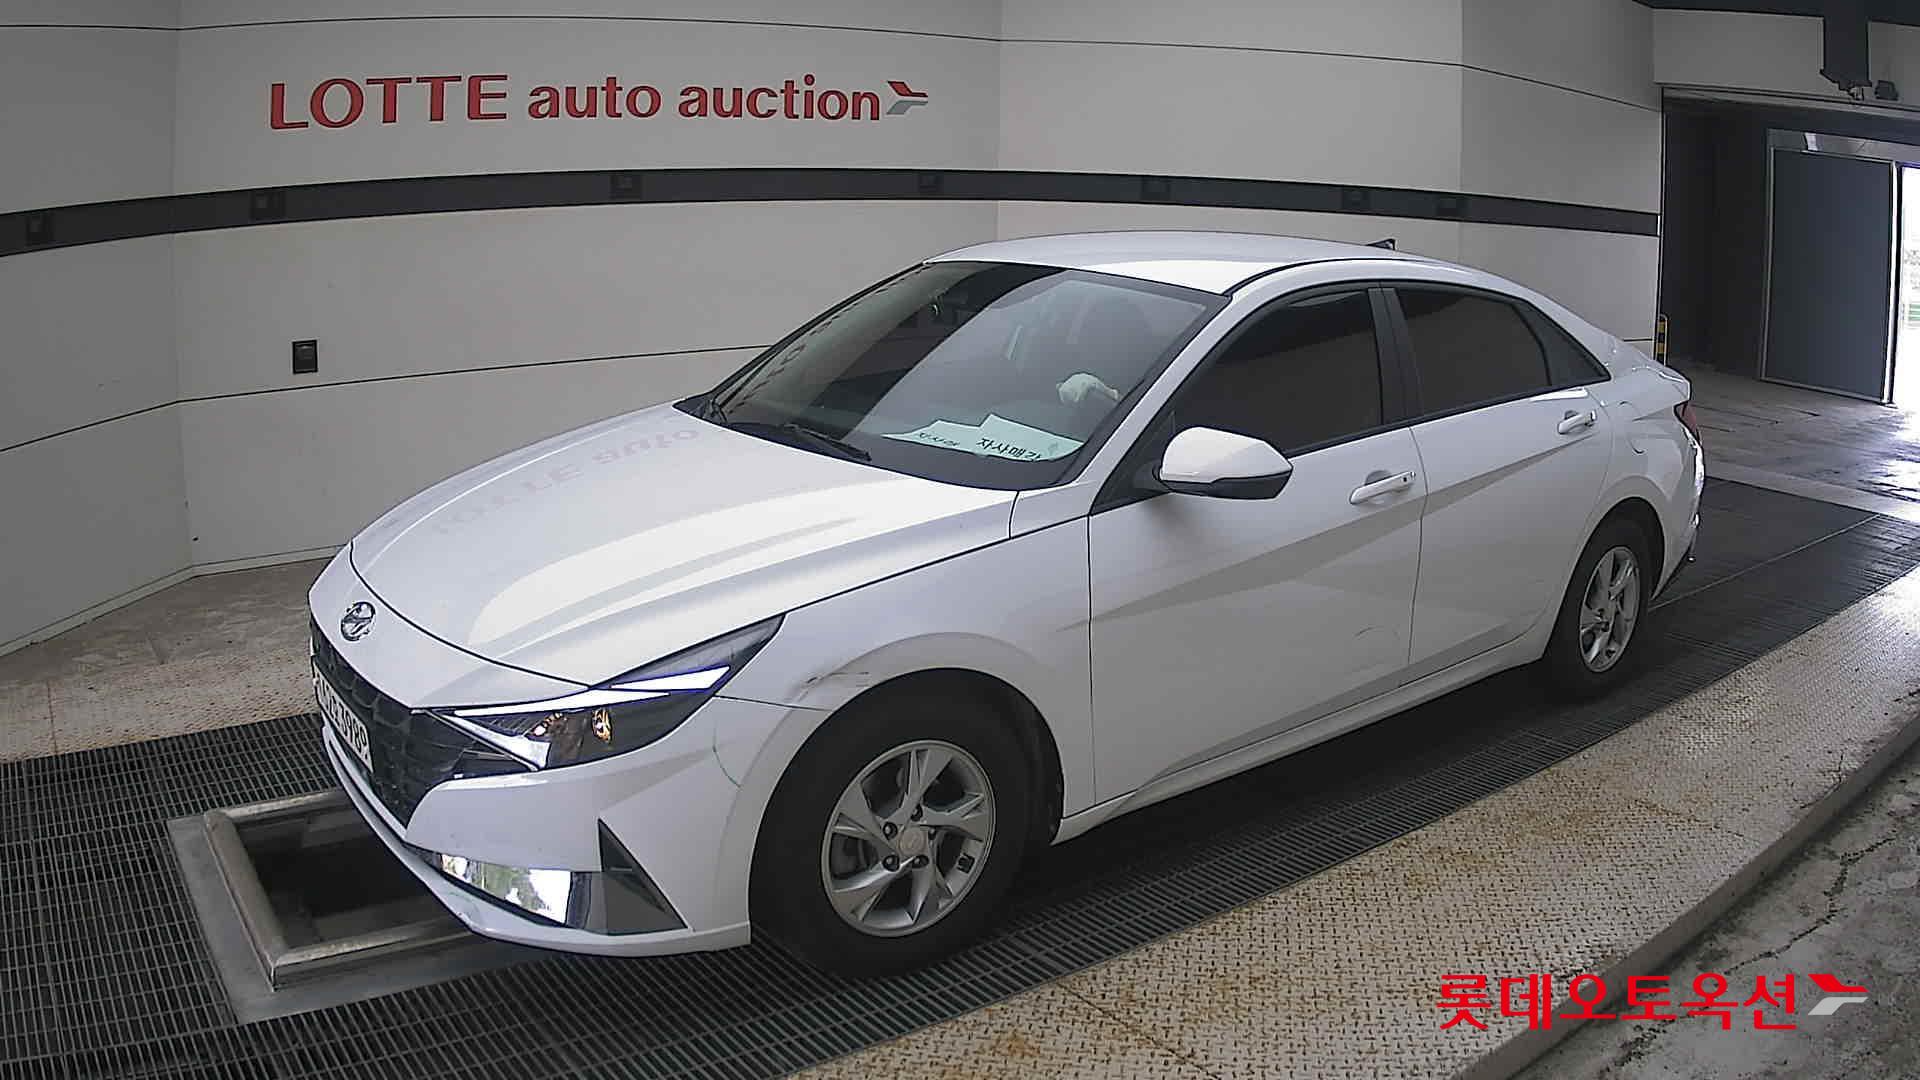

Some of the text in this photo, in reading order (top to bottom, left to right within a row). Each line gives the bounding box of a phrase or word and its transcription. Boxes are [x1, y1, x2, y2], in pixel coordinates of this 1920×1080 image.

[270, 73, 881, 130] LOTTE auto auction
